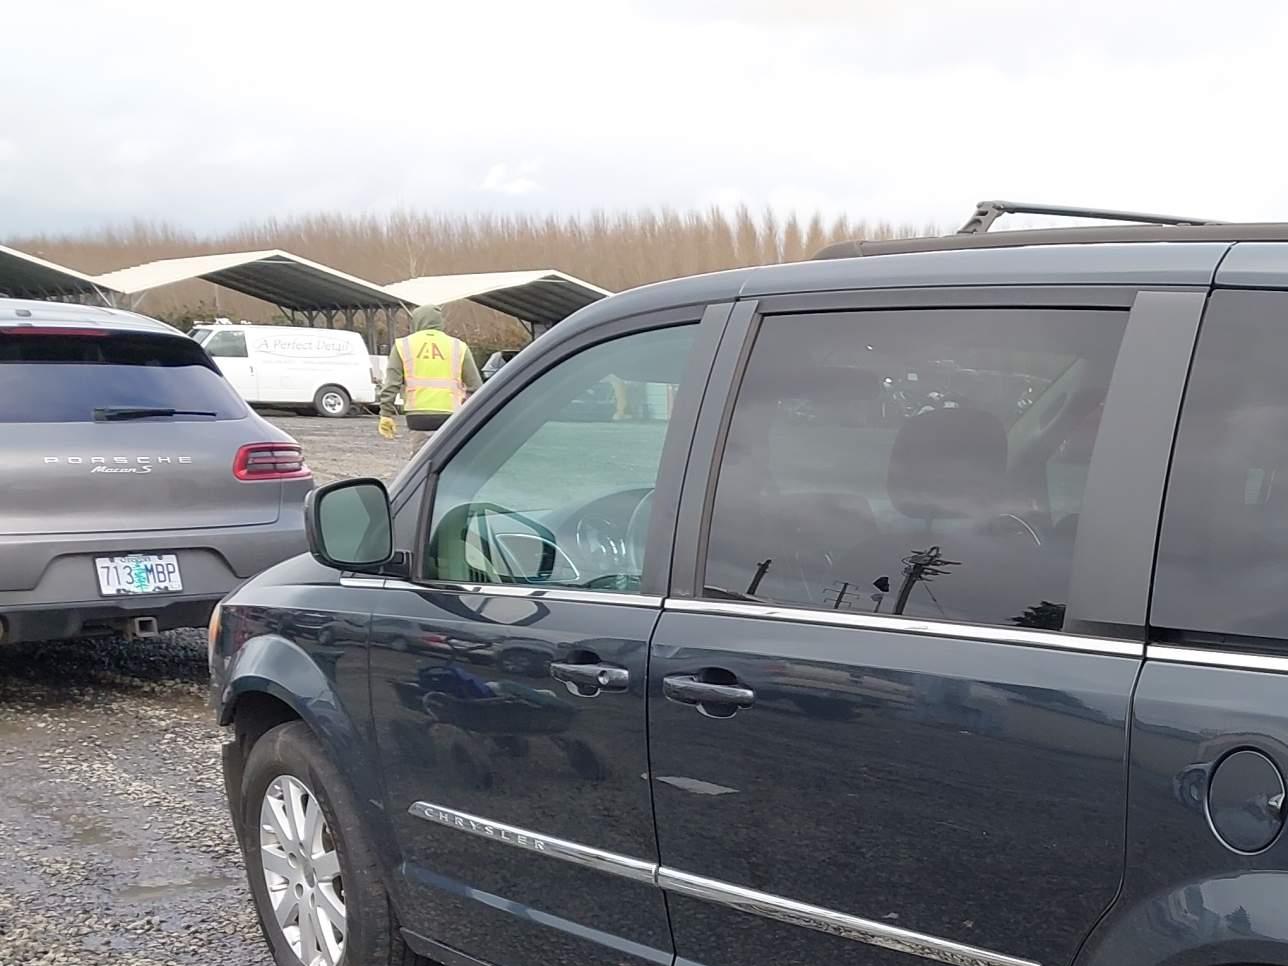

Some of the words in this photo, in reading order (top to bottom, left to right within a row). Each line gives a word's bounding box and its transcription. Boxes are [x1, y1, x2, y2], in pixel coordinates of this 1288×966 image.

[44, 456, 193, 464] PORSCHE
[101, 565, 134, 586] 713
[144, 562, 176, 585] MBP
[424, 808, 545, 851] CHRYSLER
